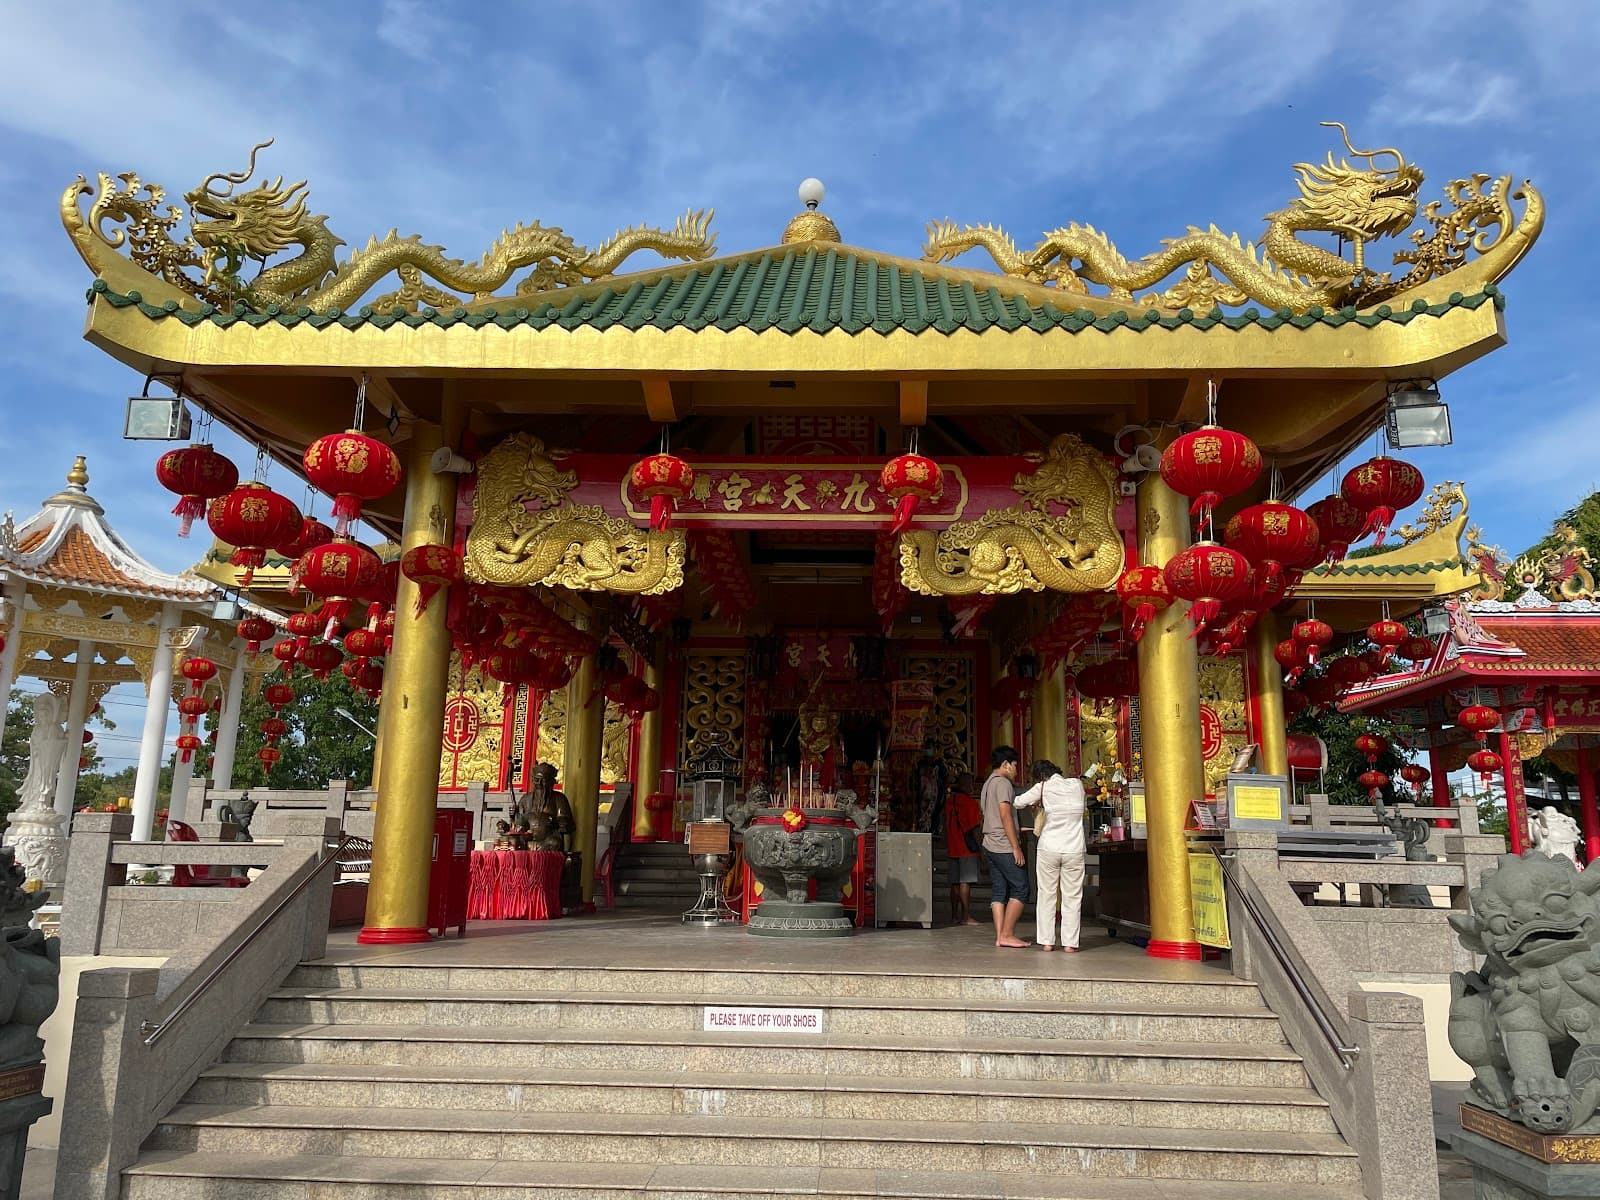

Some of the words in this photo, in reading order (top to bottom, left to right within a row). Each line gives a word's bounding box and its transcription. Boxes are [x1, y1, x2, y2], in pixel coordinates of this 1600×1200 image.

[710, 1013, 737, 1025] PLEASE
[738, 1013, 756, 1026] TAKE
[757, 1014, 771, 1026] OFF
[772, 1014, 792, 1027] YOUR
[793, 1015, 817, 1027] SHOES
